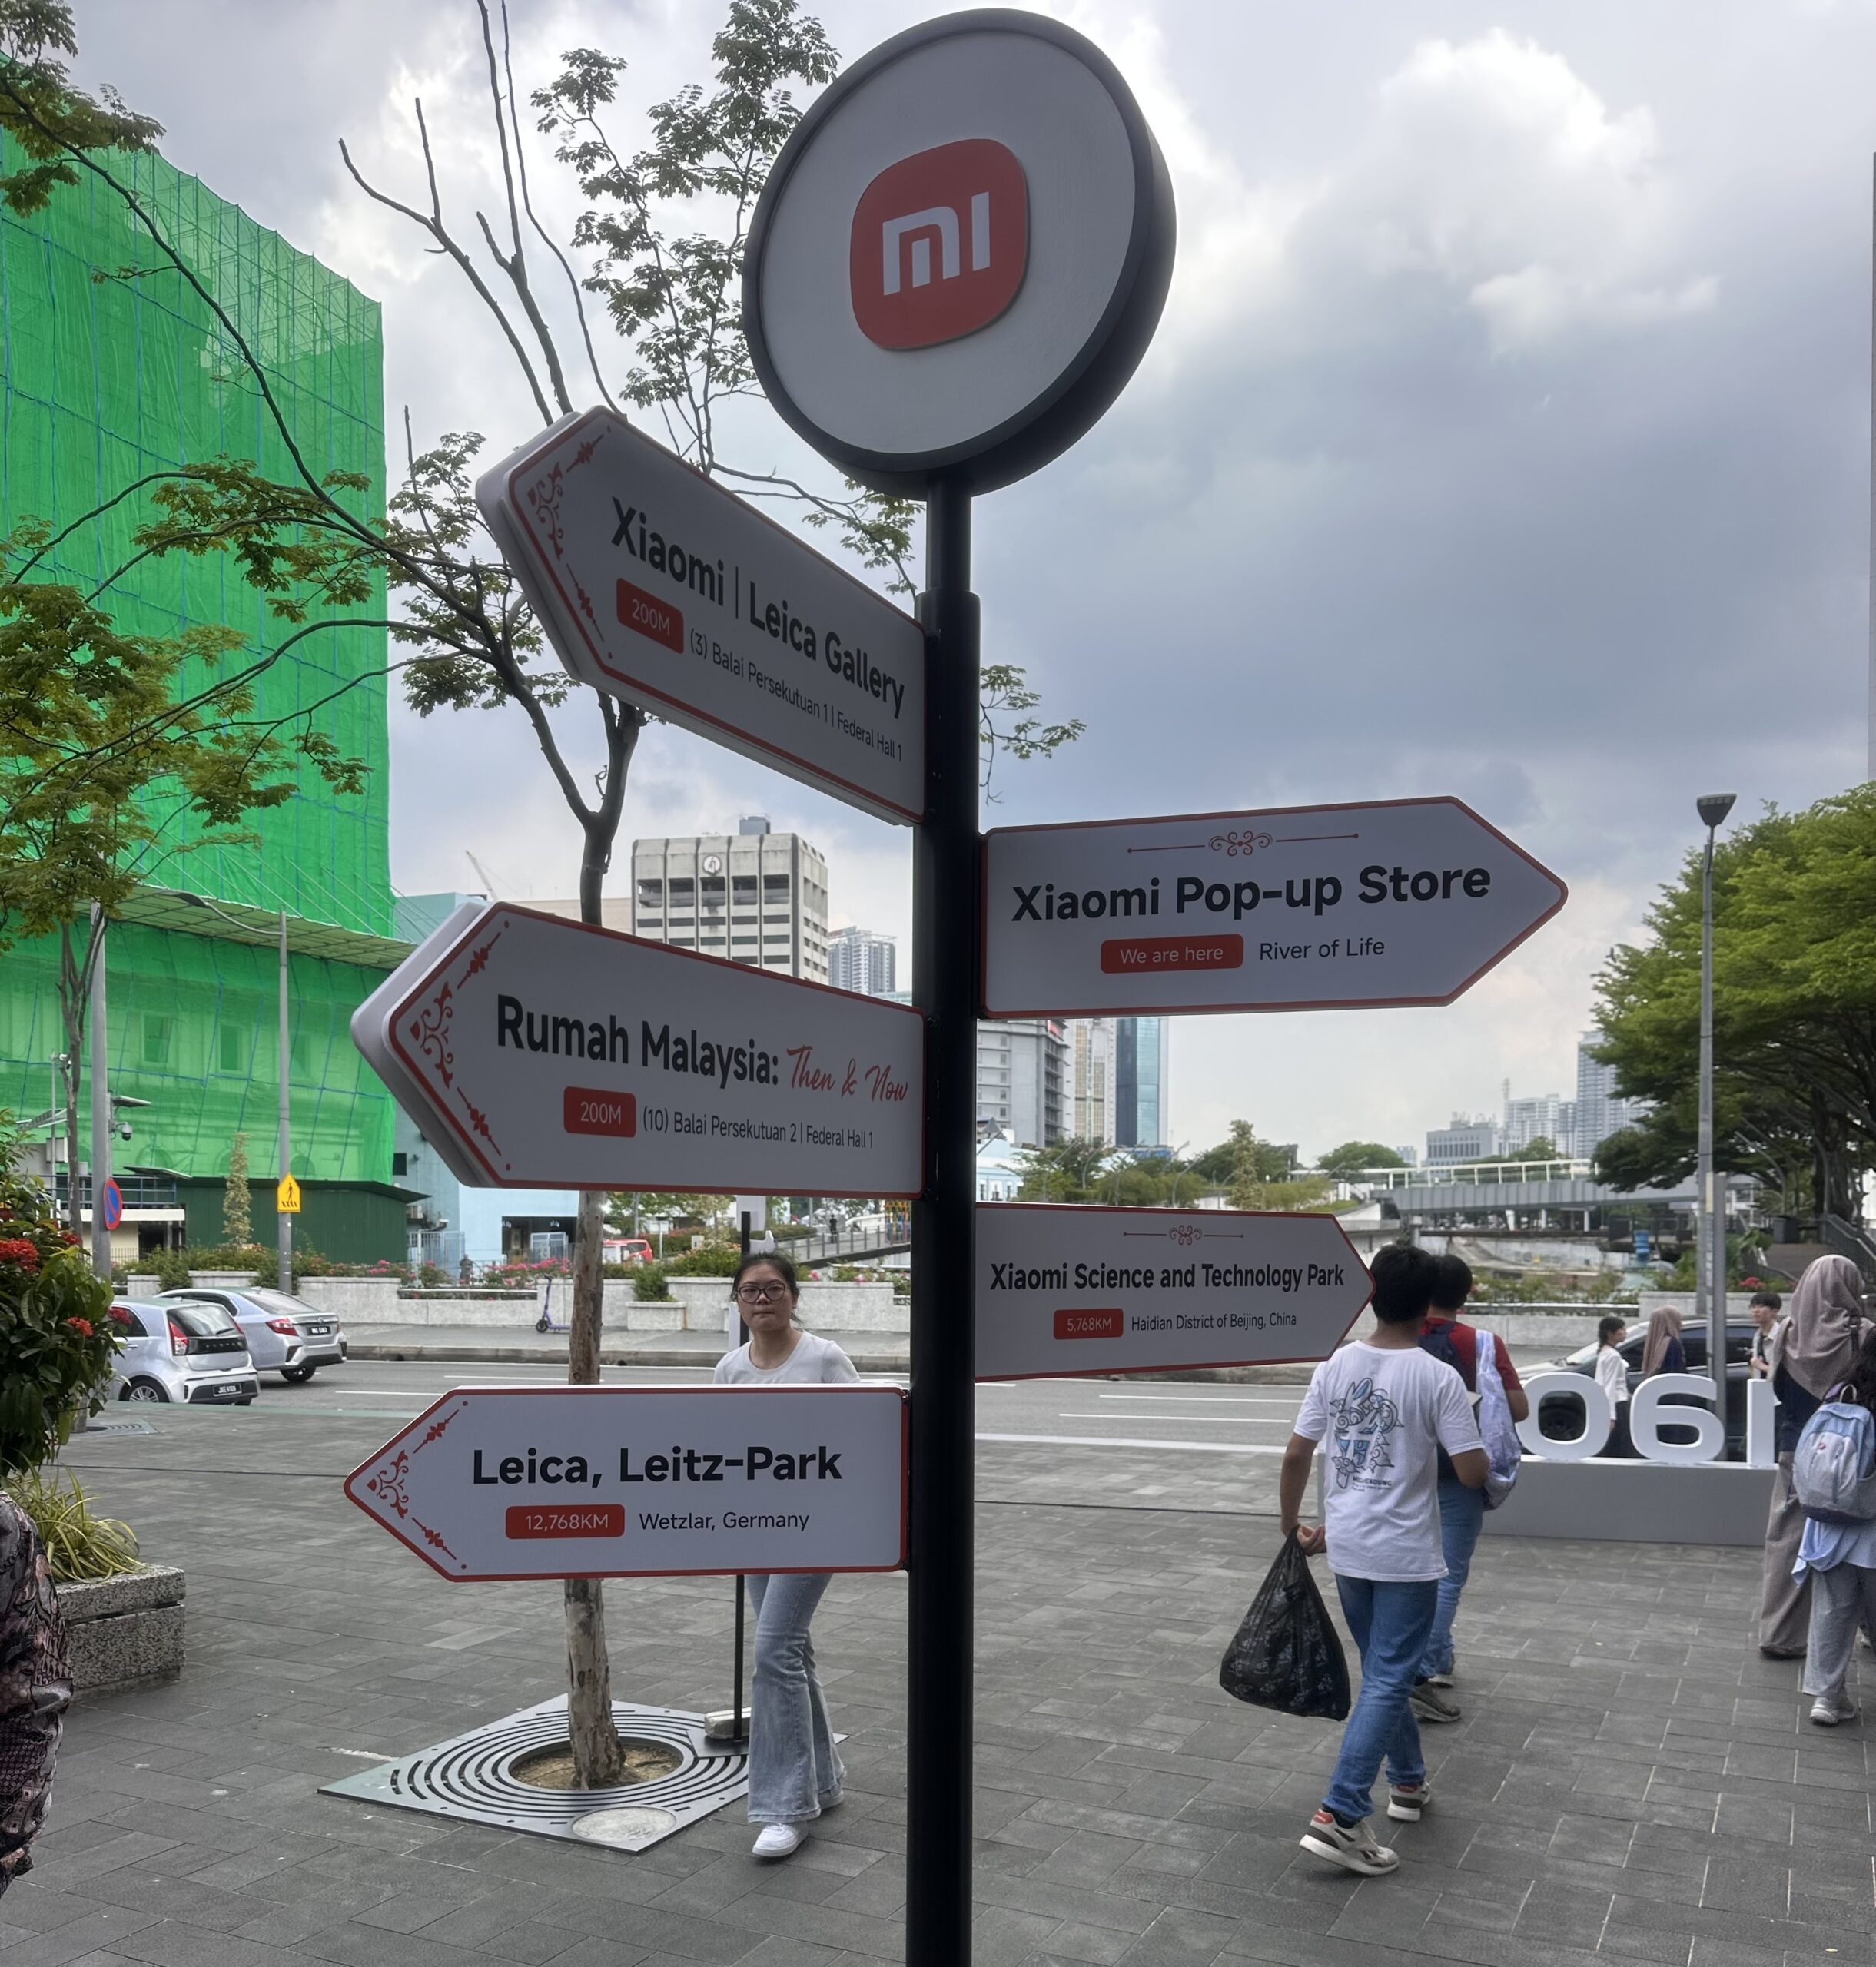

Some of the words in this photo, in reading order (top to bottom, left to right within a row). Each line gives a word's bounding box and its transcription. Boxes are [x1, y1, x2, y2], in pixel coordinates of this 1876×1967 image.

[612, 496, 723, 605] Xiaomi
[750, 581, 815, 661] Leica
[824, 631, 905, 719] Gallery
[632, 599, 670, 635] 200M
[690, 628, 707, 659] (3)
[713, 643, 743, 678] Balai
[749, 661, 820, 718] Persekutuan
[823, 702, 828, 723] 1
[838, 711, 874, 747] Federal
[877, 733, 895, 758] Hall
[897, 743, 902, 762] 1
[1011, 877, 1159, 921] Xiaomi
[1177, 872, 1342, 920] Pop-up
[1359, 865, 1490, 903] Store
[1120, 948, 1147, 963] We
[1153, 947, 1179, 962] are
[1185, 945, 1224, 961] here
[1260, 942, 1312, 960] River
[1319, 940, 1339, 957] of
[1346, 938, 1385, 956] Life
[496, 995, 629, 1063] Rumah
[642, 1021, 778, 1090] Malaysia:
[786, 1045, 836, 1092] Then
[841, 1059, 857, 1096] &
[865, 1065, 908, 1101] Now
[579, 1102, 622, 1125] 200M
[643, 1106, 669, 1134] (10)
[674, 1112, 706, 1136] Balai
[712, 1116, 785, 1142] Persekutuan
[789, 1123, 796, 1142] 2
[806, 1126, 844, 1146] Federal
[848, 1129, 866, 1148] Hall
[868, 1130, 874, 1149] 1
[990, 1263, 1067, 1289] Xiaomi
[1074, 1263, 1154, 1289] Science
[1160, 1264, 1195, 1288] and
[1202, 1264, 1302, 1292] Technology
[1308, 1264, 1343, 1286] Park
[1067, 1318, 1111, 1332] 5,768KM
[1131, 1316, 1173, 1331] Haidian
[1176, 1315, 1212, 1329] District
[1217, 1314, 1228, 1328] of
[1230, 1314, 1266, 1330] Beijing,
[1270, 1312, 1296, 1327] China
[473, 1448, 603, 1488] Leica,
[619, 1446, 842, 1483] Leitz-Park
[525, 1514, 609, 1531] 12,768KM
[639, 1512, 716, 1531] Wetzlar,
[722, 1511, 809, 1531] Germany
